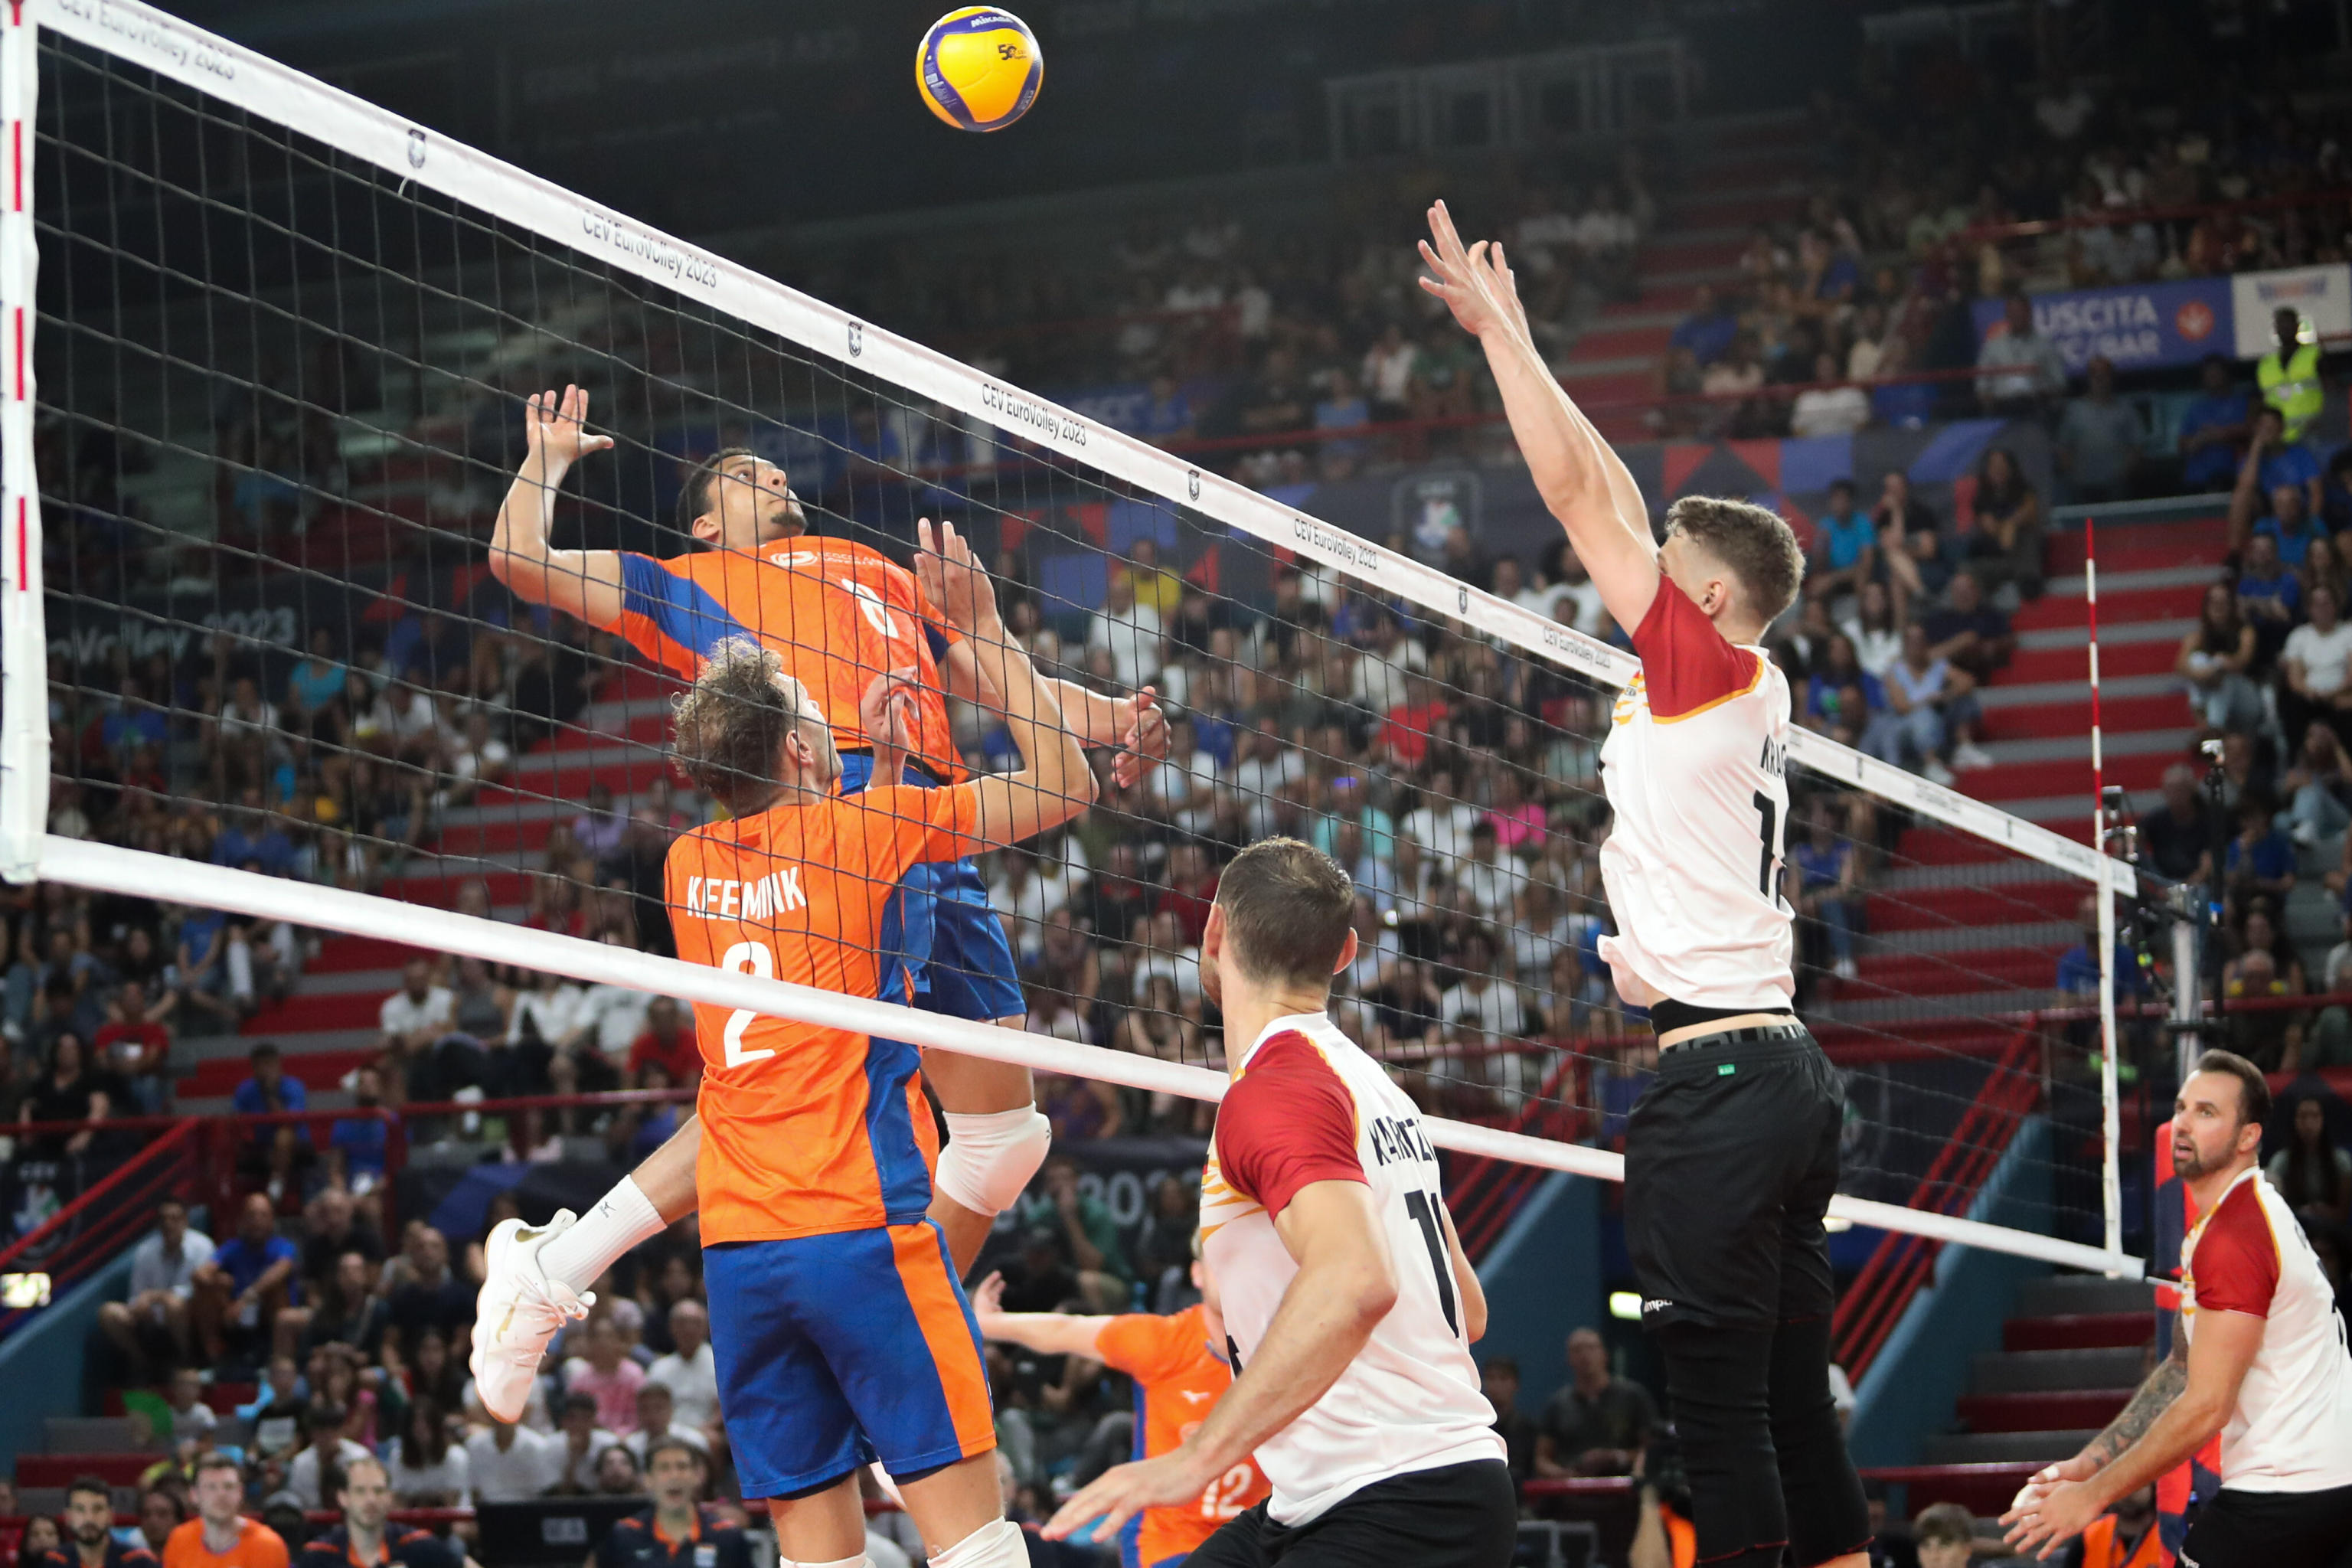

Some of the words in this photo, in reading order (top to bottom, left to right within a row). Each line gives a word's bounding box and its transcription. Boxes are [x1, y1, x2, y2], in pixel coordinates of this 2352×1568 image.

[583, 209, 611, 242] CEV
[614, 222, 683, 279] EuroVolley
[685, 254, 717, 288] 2023
[2033, 295, 2158, 332] USCITA
[982, 383, 1004, 411] CEV
[1007, 393, 1060, 439] EuroVolley
[1062, 417, 1086, 446] 2023
[1295, 518, 1312, 543] CEV
[1314, 526, 1356, 566] EuroVolley
[1358, 545, 1378, 570] 2023
[841, 578, 900, 639] 8
[687, 867, 807, 921] KEEMINK
[722, 941, 776, 1068] 2
[1201, 1462, 1253, 1518] 12
